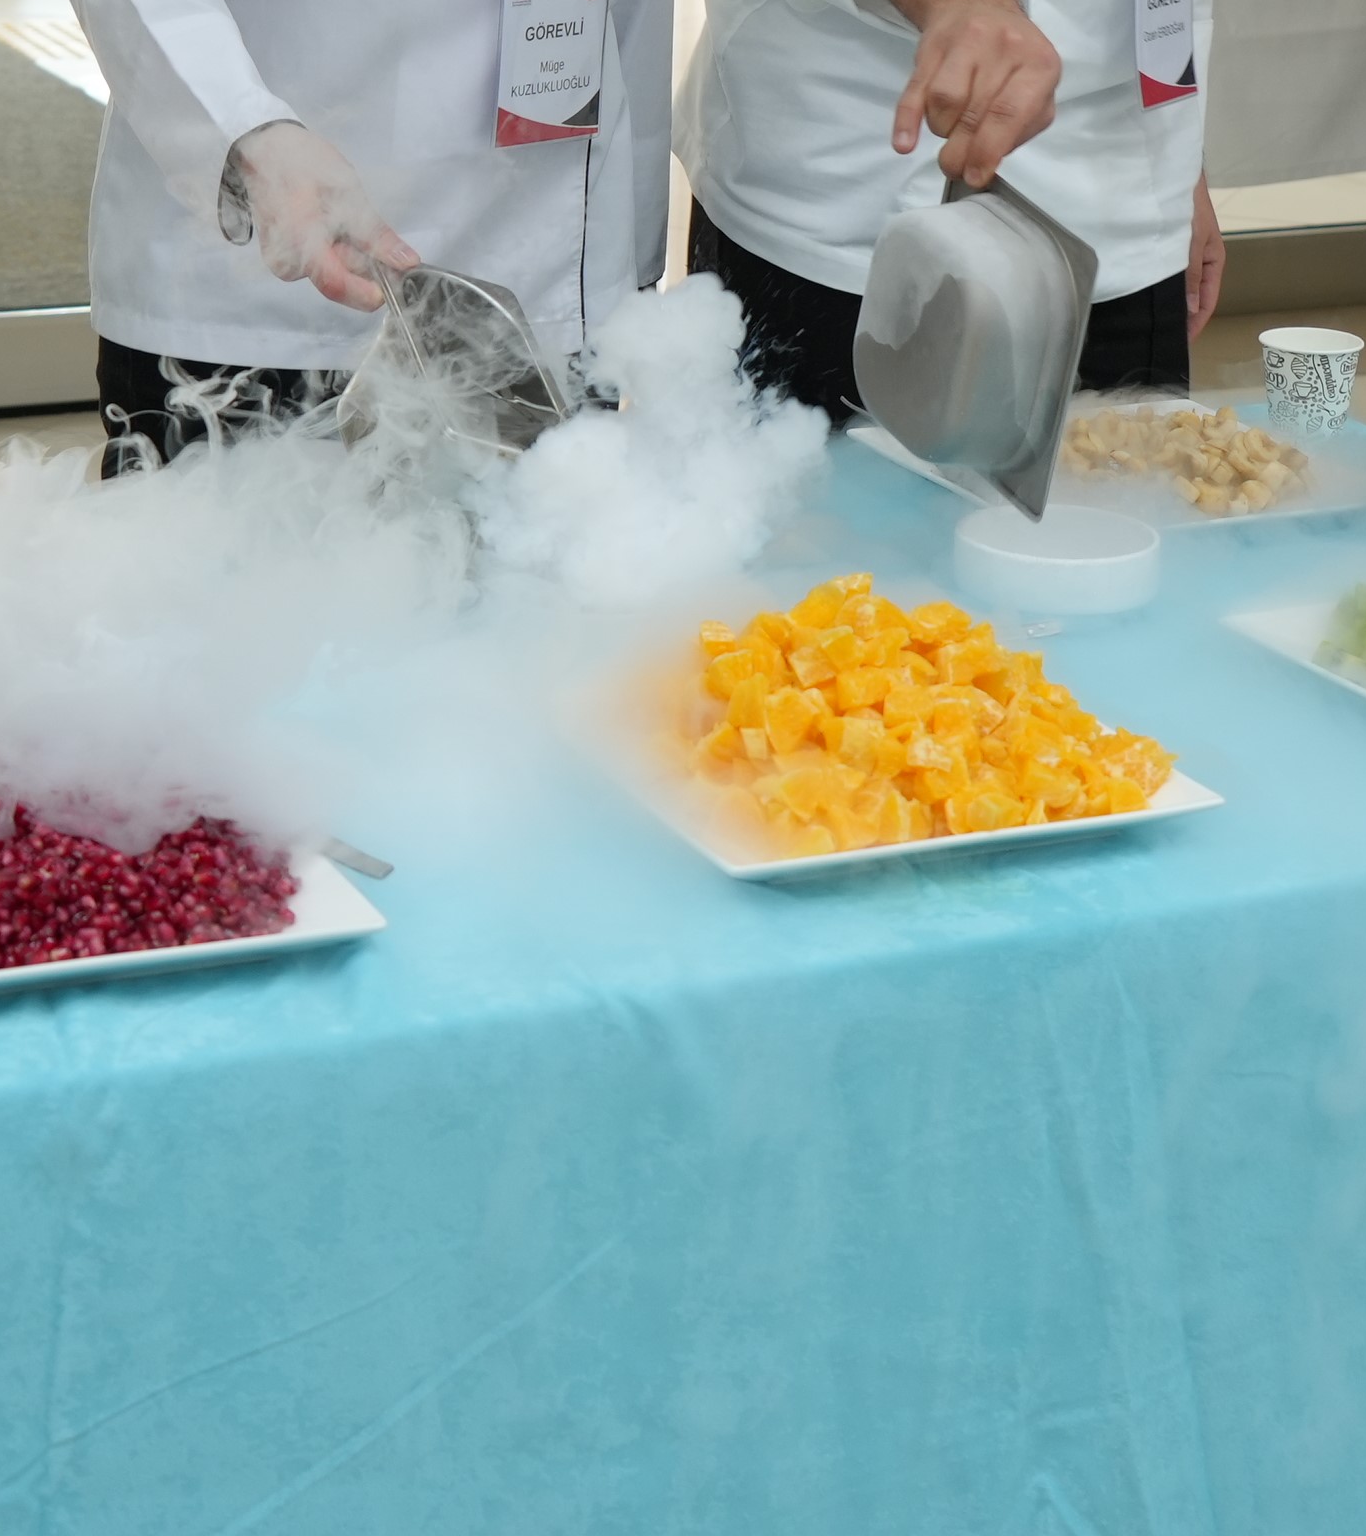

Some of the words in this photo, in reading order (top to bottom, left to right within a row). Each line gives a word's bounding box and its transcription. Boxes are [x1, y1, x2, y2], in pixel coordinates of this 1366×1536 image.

[525, 16, 584, 42] GÖREVLİ
[539, 61, 565, 74] Müge
[510, 75, 591, 98] KUZLUKLUOĞLU
